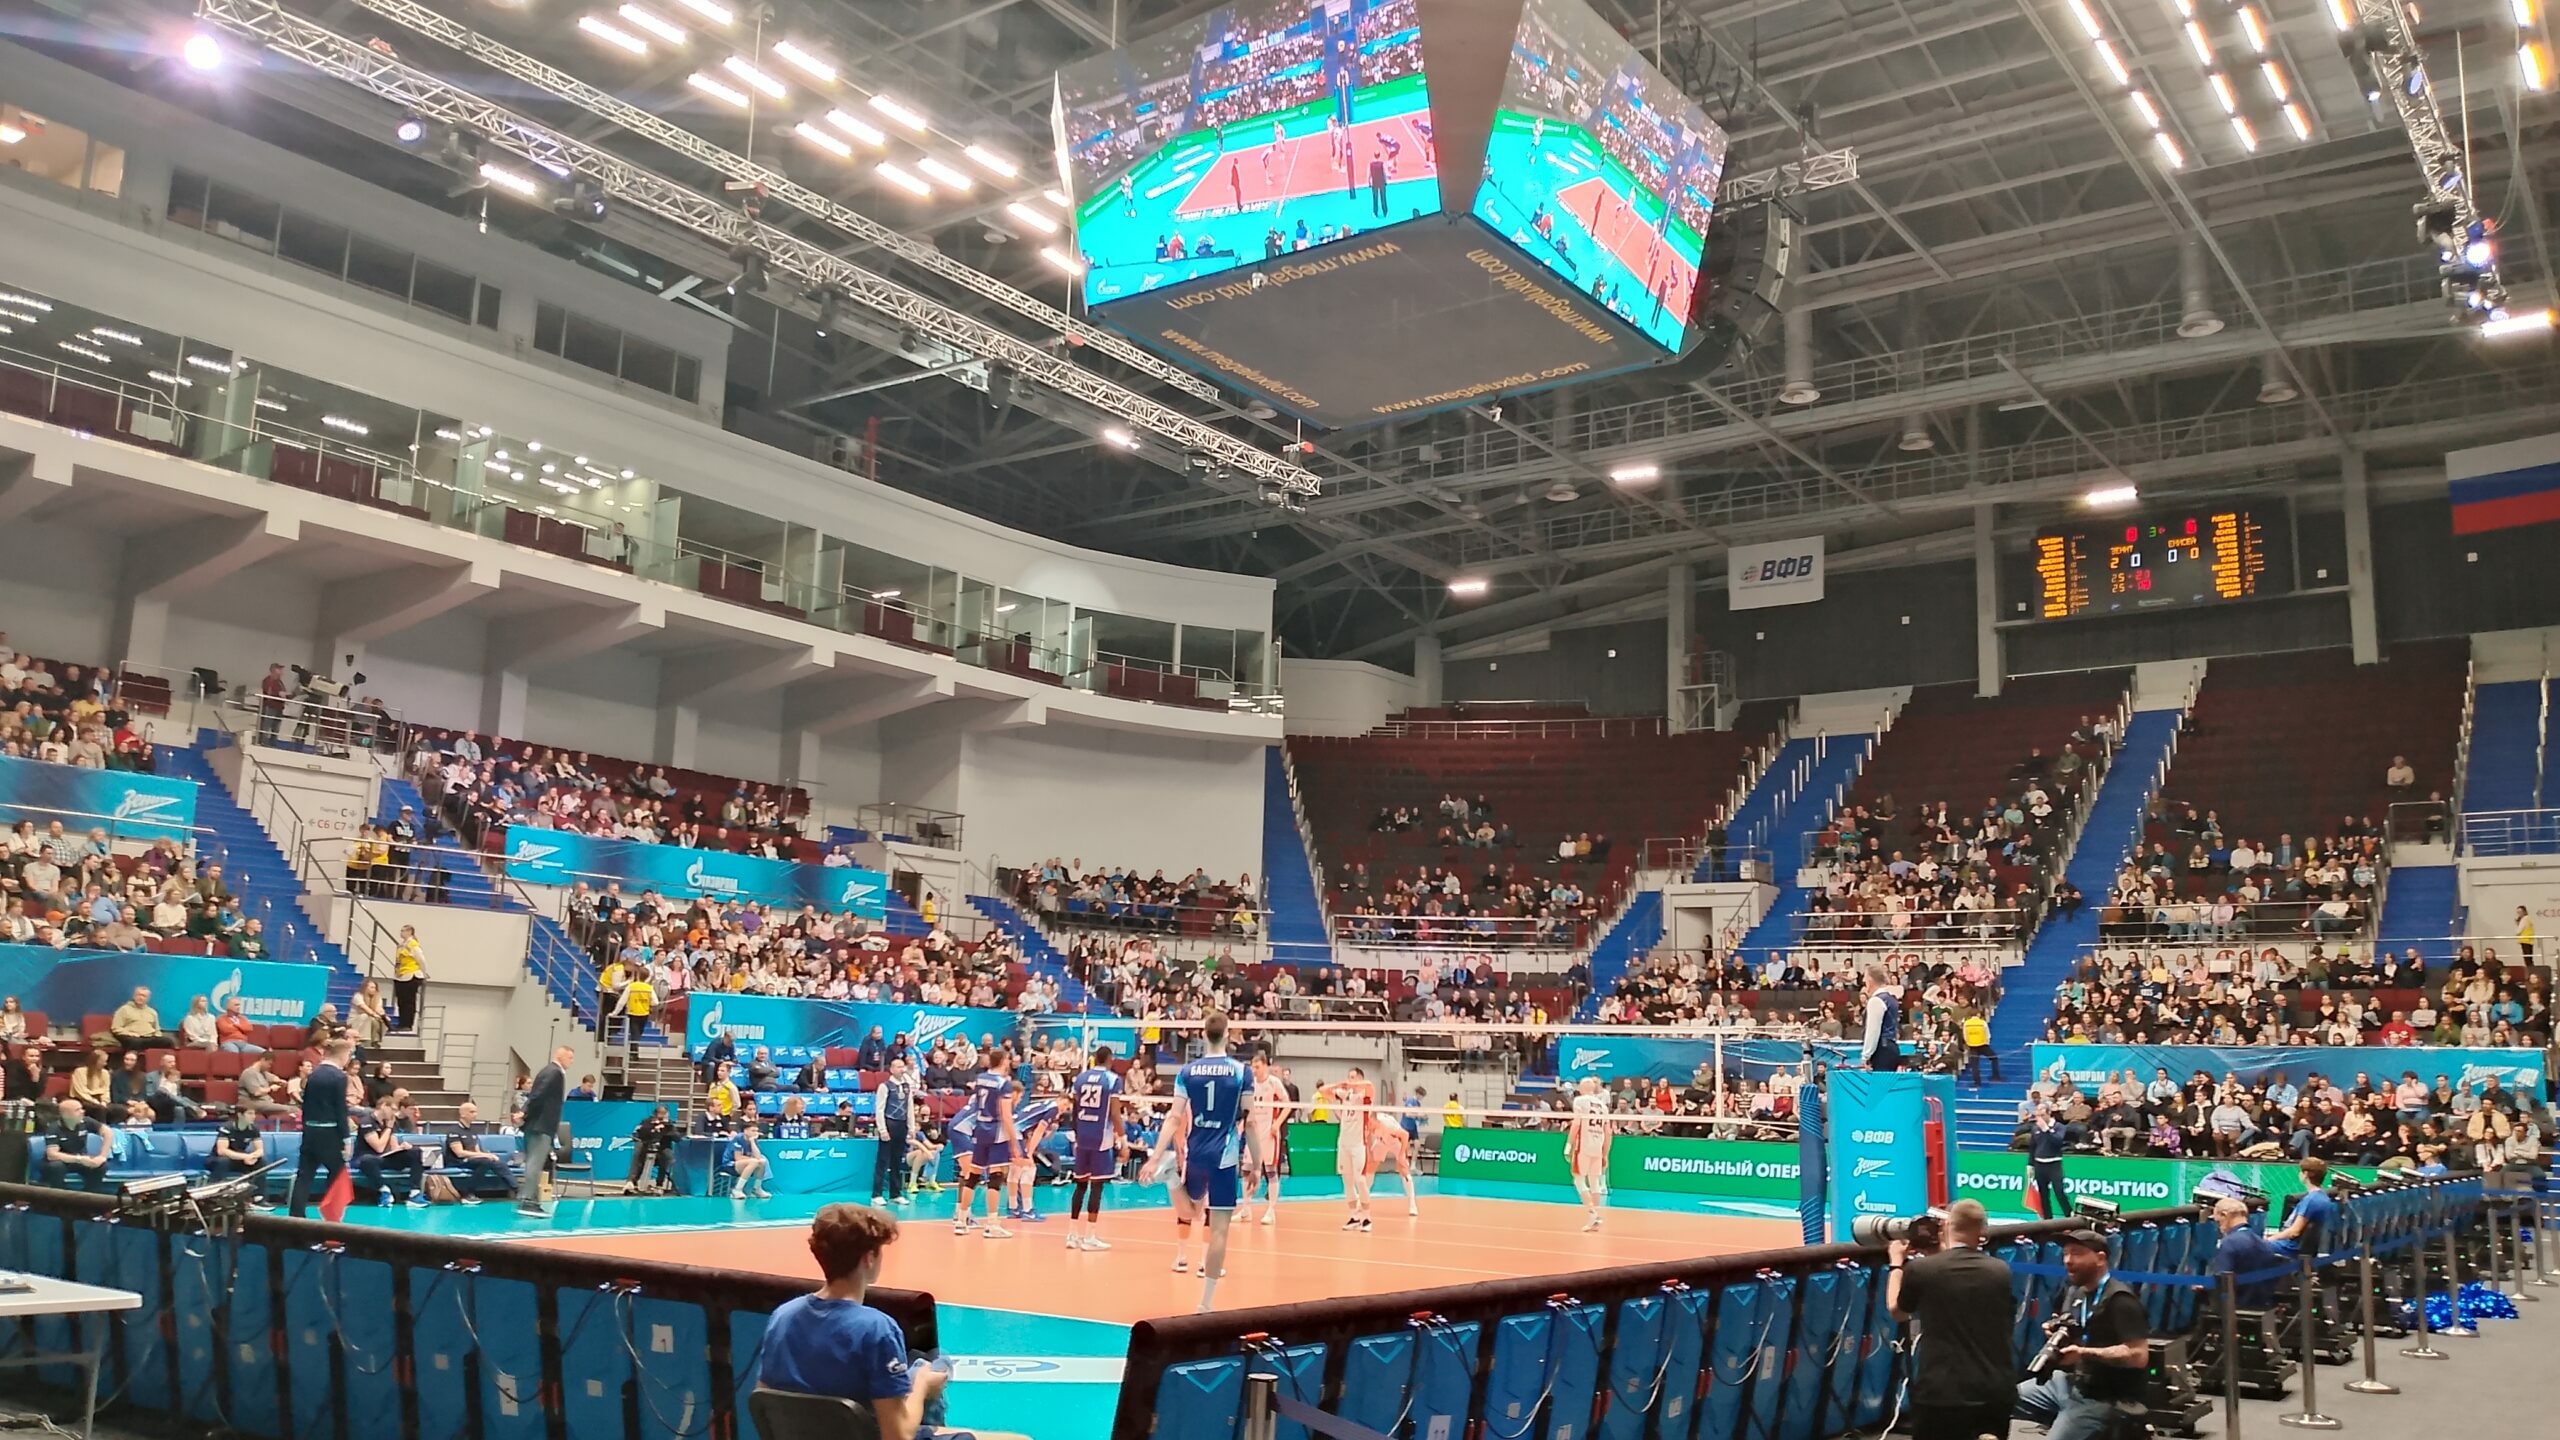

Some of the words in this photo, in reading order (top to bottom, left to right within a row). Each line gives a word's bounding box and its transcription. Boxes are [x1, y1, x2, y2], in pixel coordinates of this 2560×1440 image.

[1372, 361, 1590, 413] www.megaluxltd.com
[2149, 526, 2156, 537] 3
[1760, 554, 1813, 581] ВФВ
[2110, 557, 2119, 568] 2
[2130, 553, 2141, 567] 0
[2168, 549, 2178, 563] 0
[2190, 547, 2199, 559] 0
[2112, 583, 2125, 593] 25
[1190, 1064, 1235, 1077] БАБКЕВИЧ
[1080, 1083, 1103, 1109] 23
[1204, 1080, 1216, 1112] 1
[1644, 1156, 1753, 1177] МОБИЛЬНЫЙ
